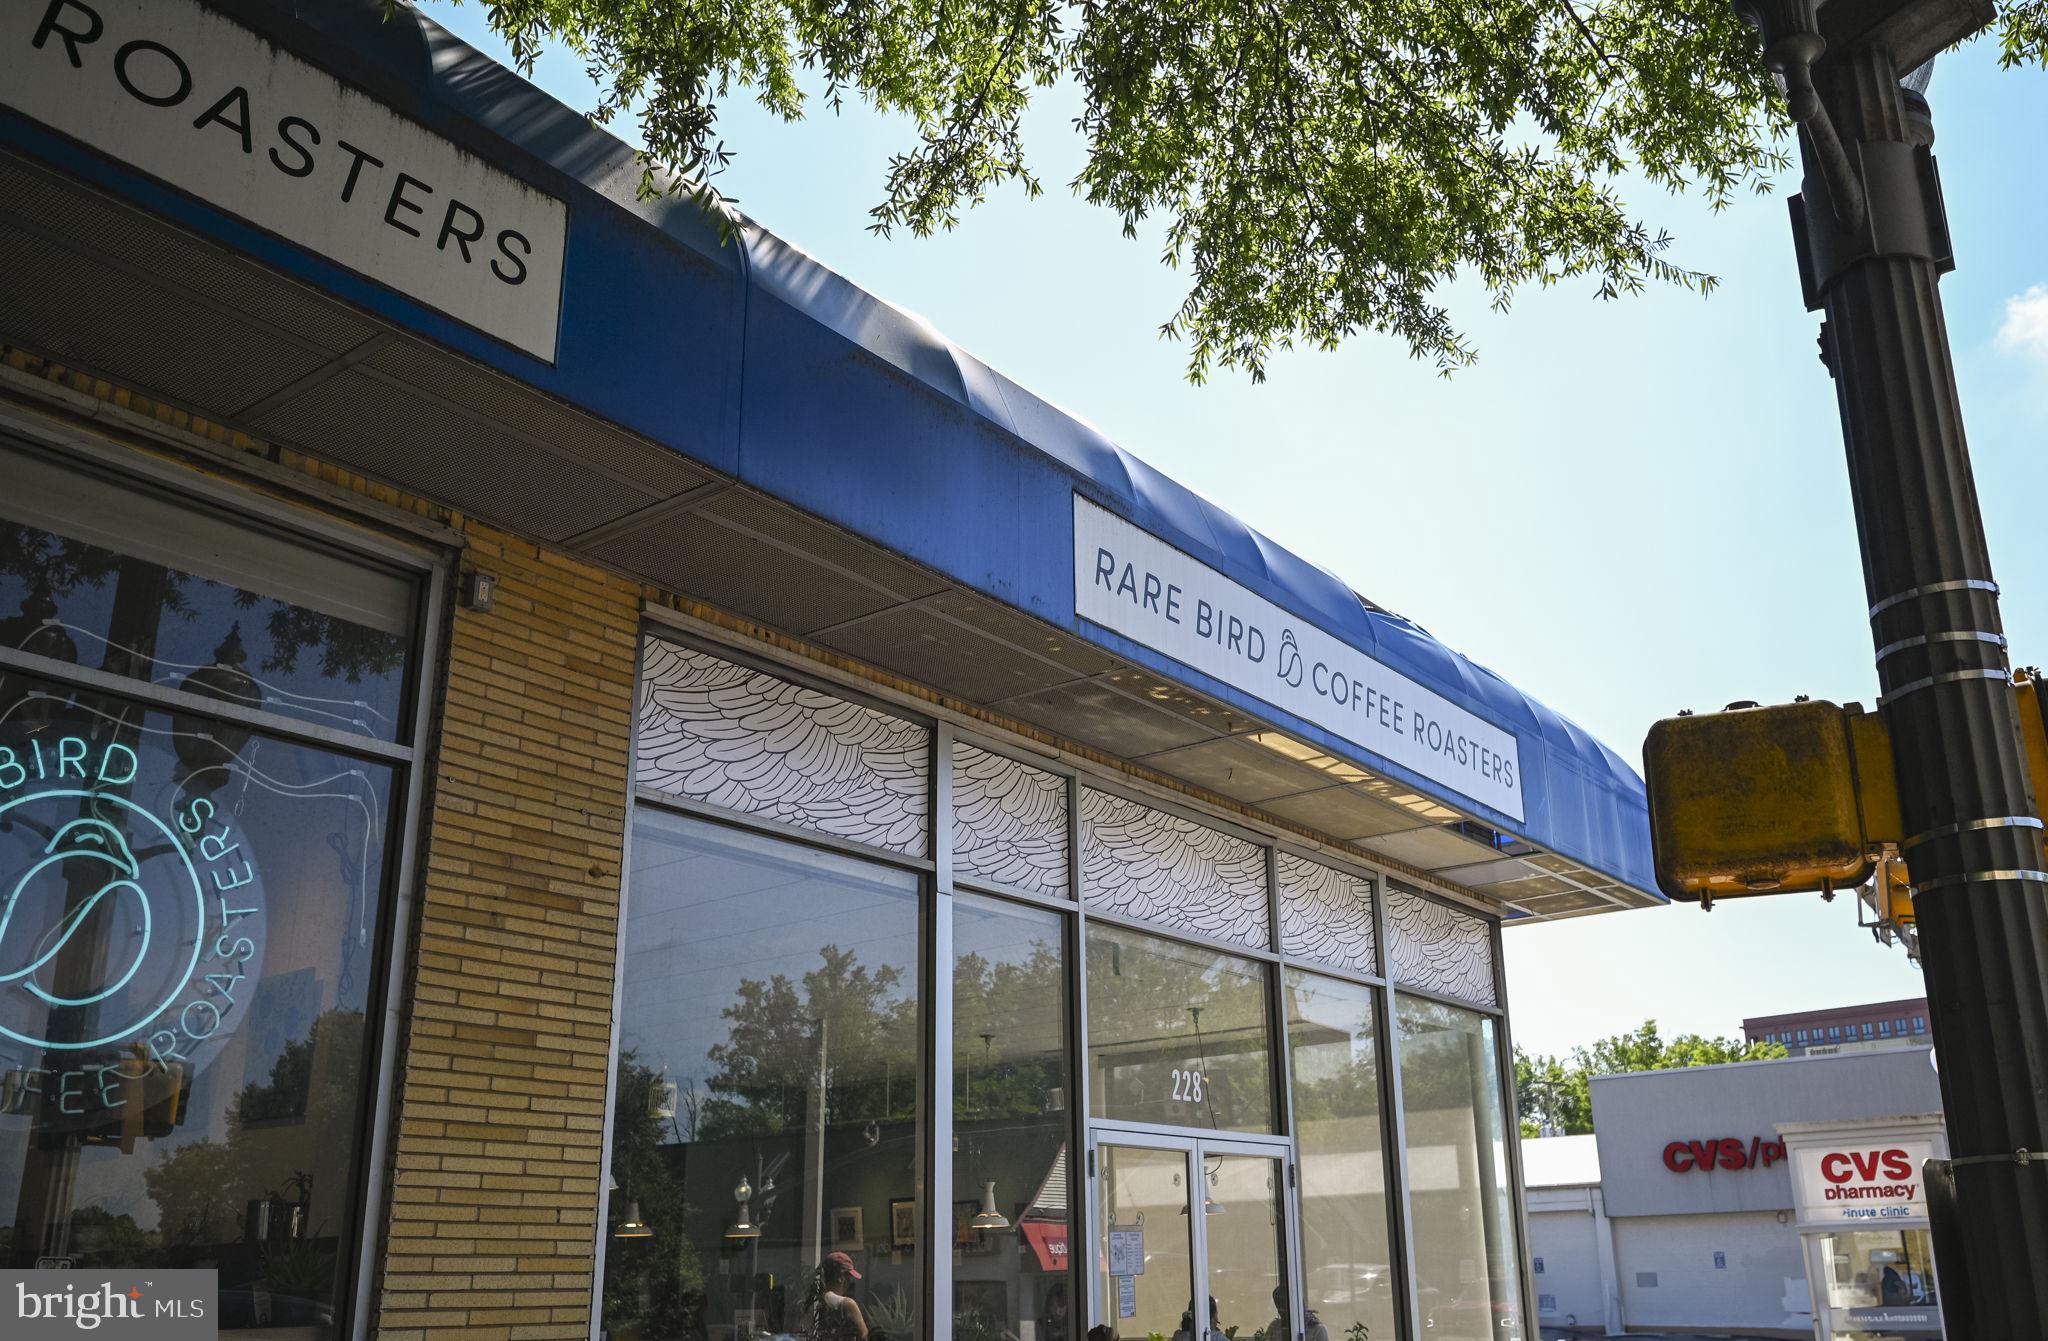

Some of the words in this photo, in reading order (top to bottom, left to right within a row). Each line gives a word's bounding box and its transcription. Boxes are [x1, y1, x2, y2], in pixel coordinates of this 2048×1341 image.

[32, 0, 532, 286] ROASTERS
[1095, 547, 1181, 625] RARE
[1196, 599, 1266, 664] BIRD
[1312, 661, 1404, 736] COFFEE
[1413, 711, 1515, 789] ROASTERS
[0, 736, 138, 789] BIRD
[150, 798, 259, 1073] ROASTERS
[14, 1064, 128, 1114] FEE
[1171, 1069, 1202, 1103] 228
[1820, 1149, 1912, 1184] CVS
[1825, 1184, 1916, 1200] pharmacy
[1842, 1207, 1877, 1218] inute
[1880, 1206, 1910, 1217] clinic
